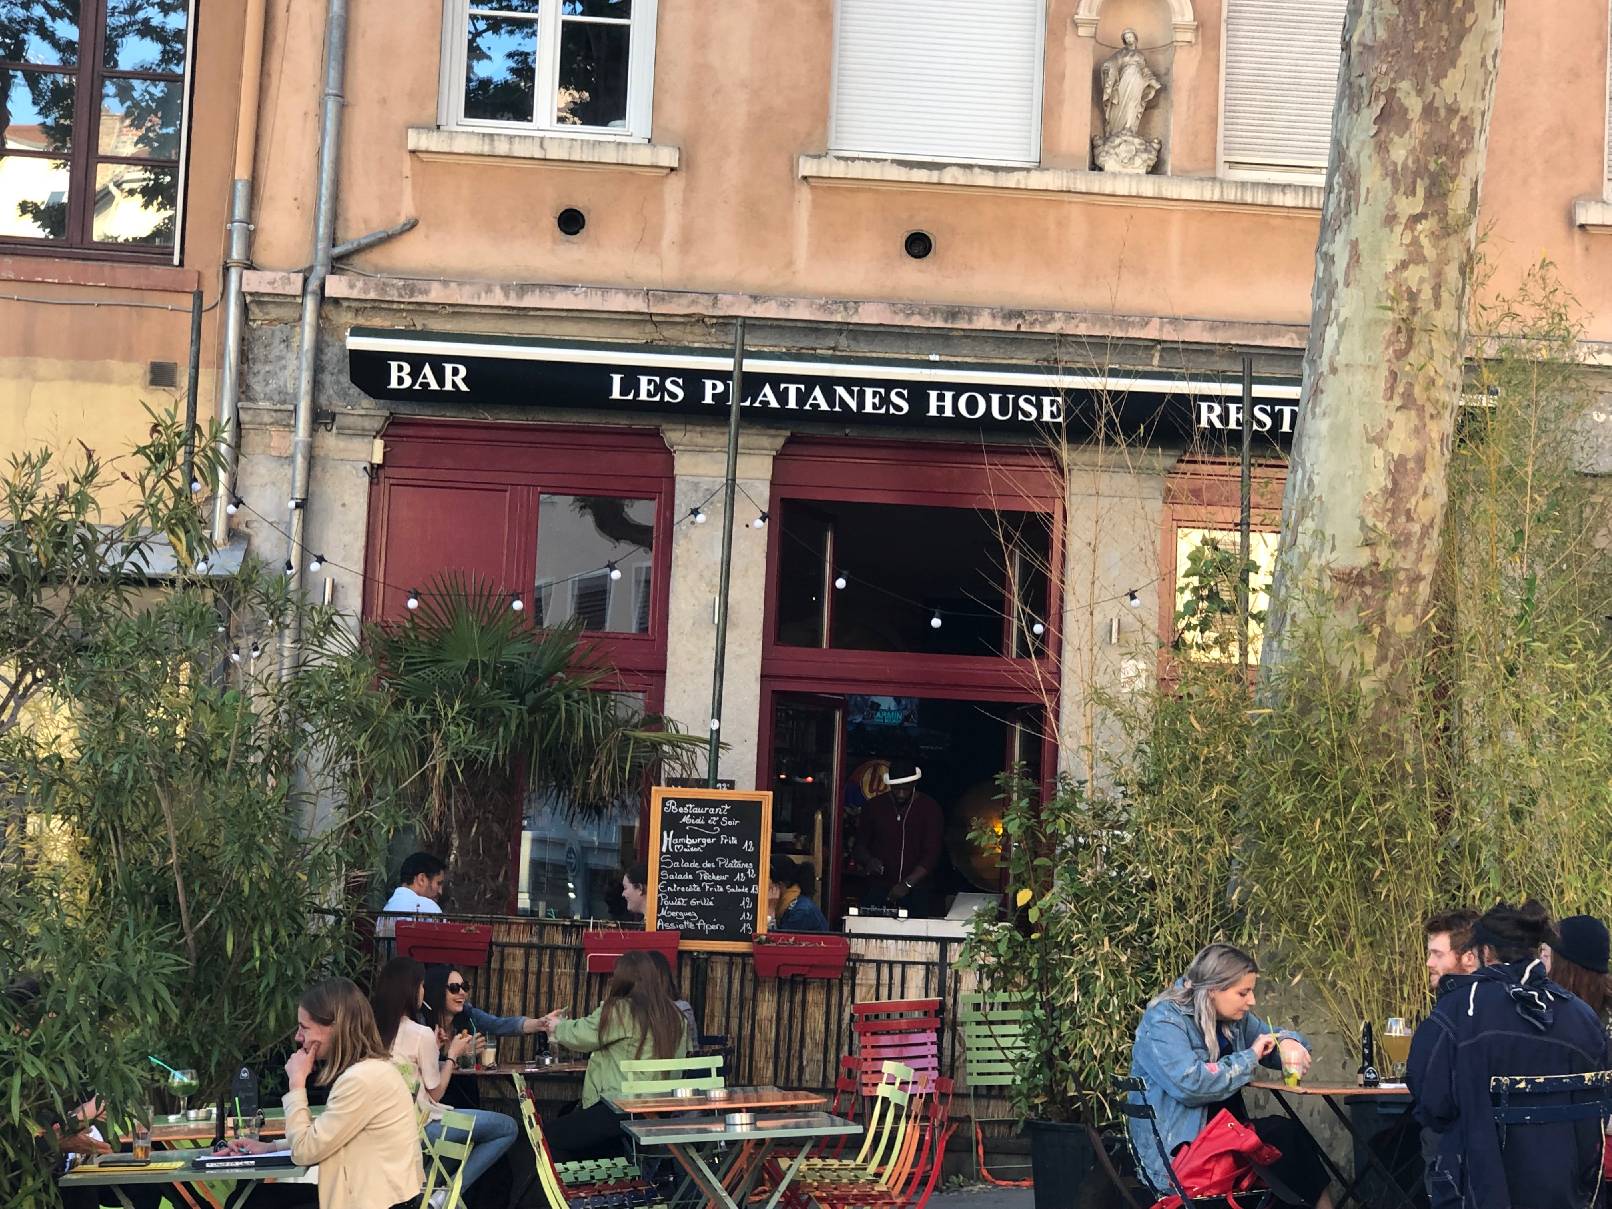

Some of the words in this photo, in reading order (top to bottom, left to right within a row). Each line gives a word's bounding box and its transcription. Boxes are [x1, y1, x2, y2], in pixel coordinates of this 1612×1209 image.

[387, 360, 470, 392] BAR
[609, 374, 685, 403] LES
[701, 378, 910, 415] PLATANES
[926, 390, 1064, 423] HOUSE
[663, 800, 732, 815] Restaurant
[680, 814, 705, 825] Midi
[708, 816, 719, 825] et
[720, 816, 740, 826] Soir
[661, 830, 716, 852] Hamburger
[742, 840, 754, 852] 12
[674, 844, 704, 853] Maison
[660, 854, 701, 869] Salade
[702, 860, 716, 868] des
[660, 870, 694, 880] Salade
[733, 872, 746, 882] 12
[747, 869, 756, 879] 12
[726, 884, 749, 893] Salade
[657, 893, 688, 906] Poulet
[657, 906, 699, 921] Merguez
[657, 918, 696, 930] Assiette
[740, 922, 753, 935] 13
